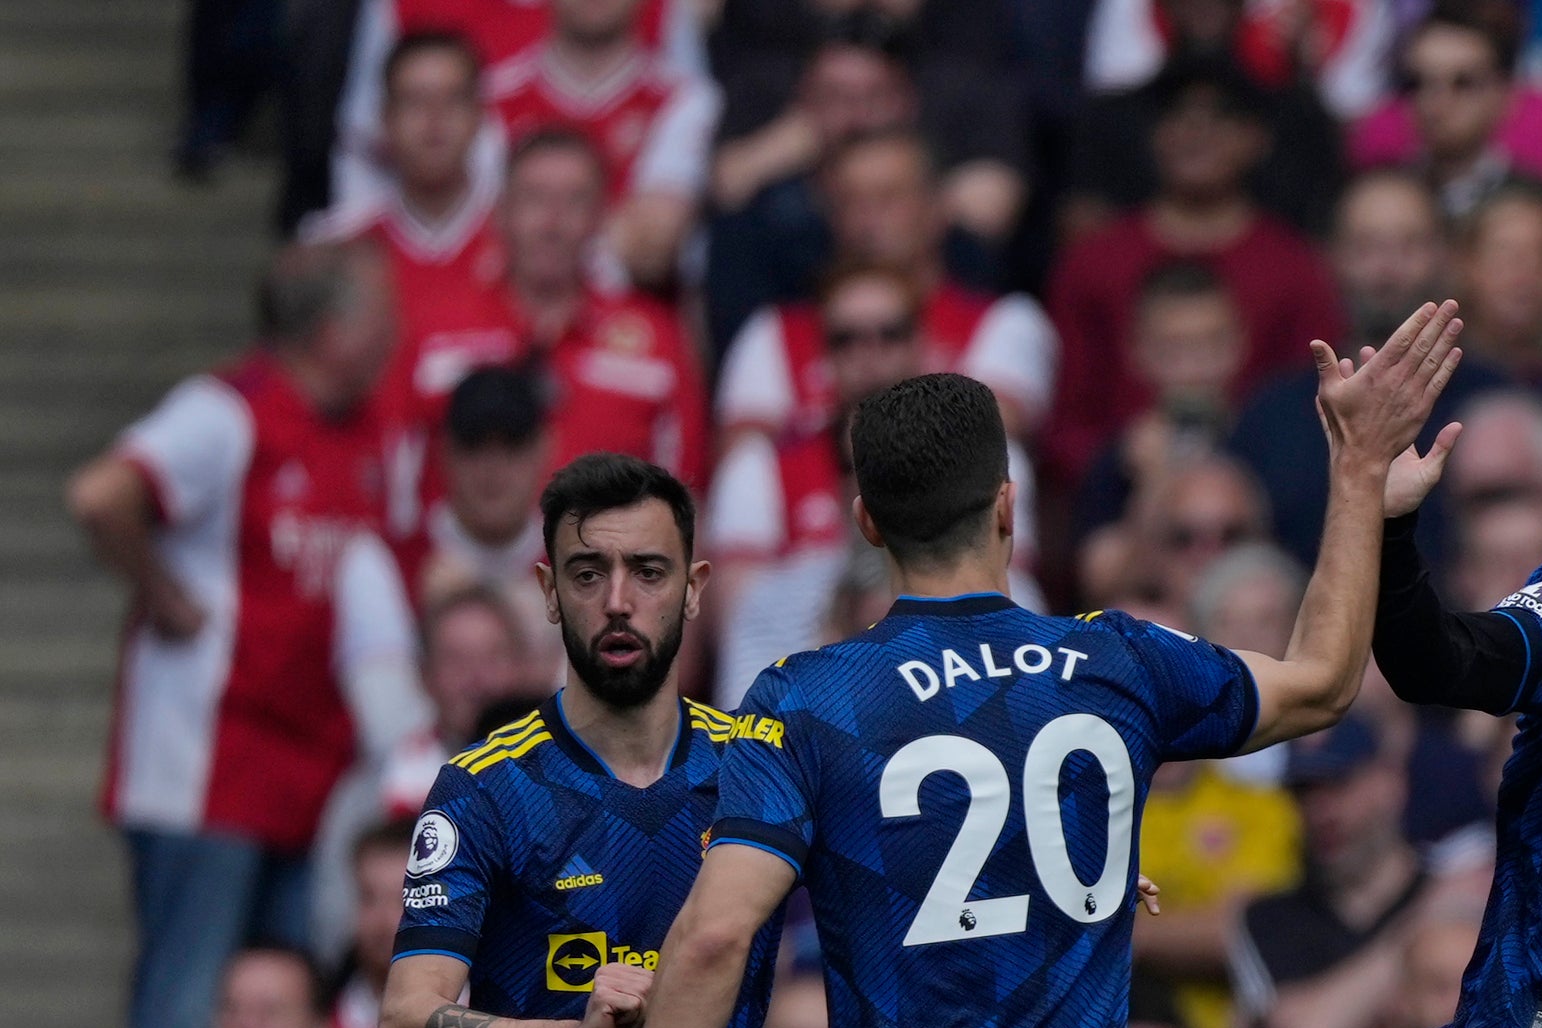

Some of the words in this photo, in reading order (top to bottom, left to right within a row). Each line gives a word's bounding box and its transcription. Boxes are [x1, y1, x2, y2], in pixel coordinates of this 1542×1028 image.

[897, 643, 1089, 702] DALOT
[726, 713, 785, 749] HLER
[879, 713, 1135, 947] 20
[555, 873, 604, 890] adidas
